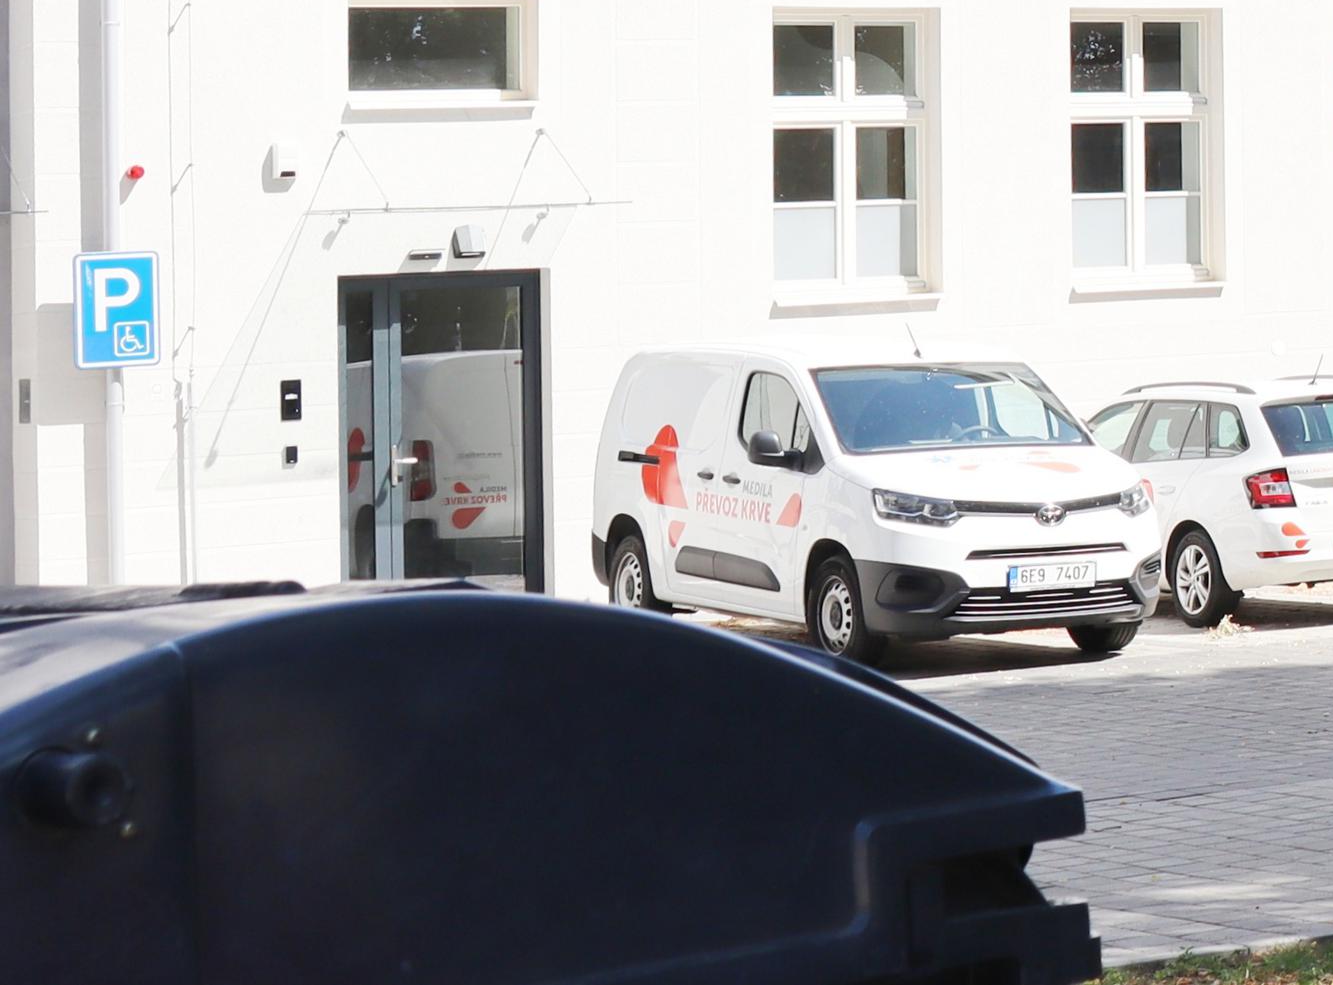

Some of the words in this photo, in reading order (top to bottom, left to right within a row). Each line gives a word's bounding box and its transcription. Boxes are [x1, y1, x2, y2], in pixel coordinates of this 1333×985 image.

[94, 268, 140, 332] P
[743, 479, 773, 498] MEDILA
[696, 488, 739, 518] PŘEVOZ
[741, 499, 772, 524] KRVE
[1021, 567, 1046, 584] 6E9
[1056, 564, 1090, 582] 7407
